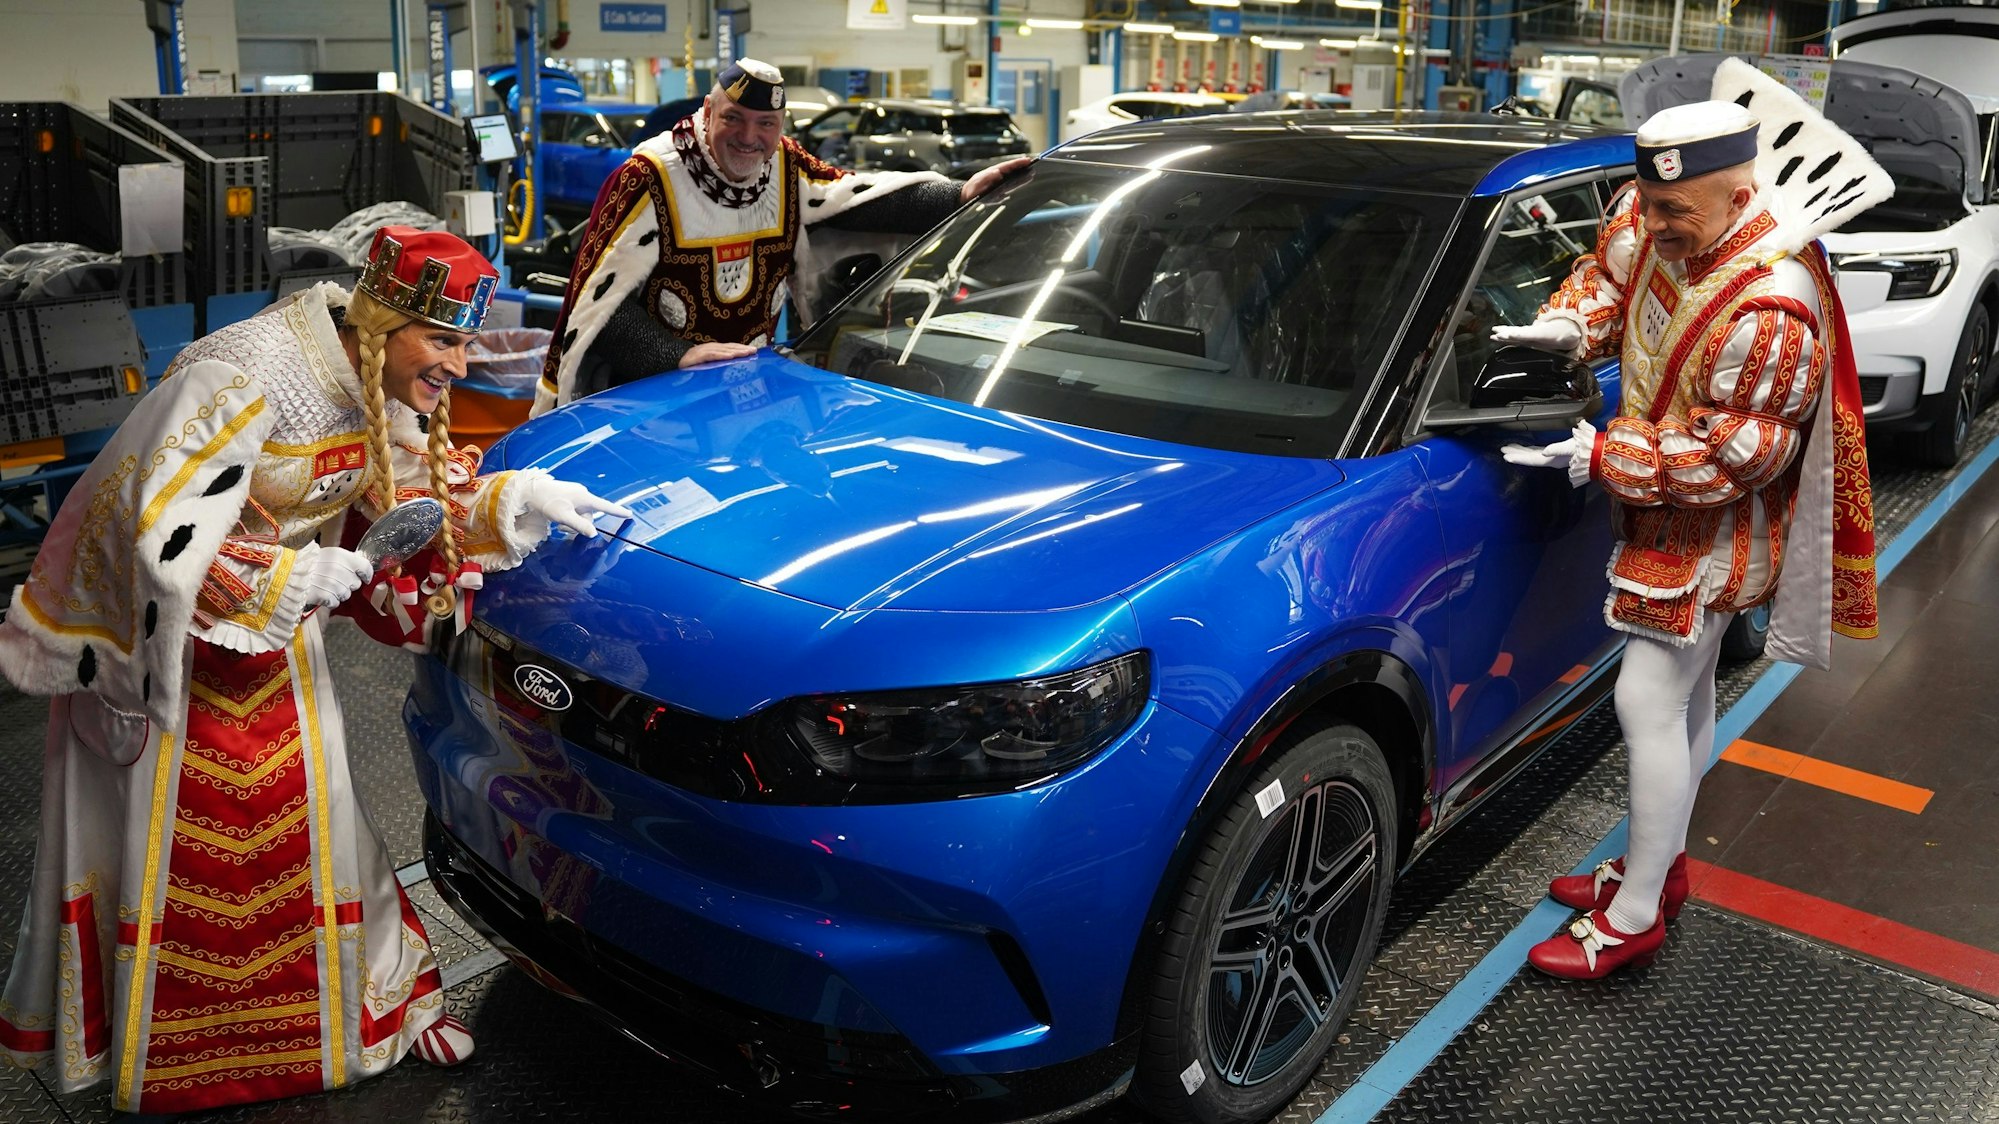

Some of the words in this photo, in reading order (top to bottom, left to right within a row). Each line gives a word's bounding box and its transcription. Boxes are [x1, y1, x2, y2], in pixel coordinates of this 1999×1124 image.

[430, 20, 445, 60] STAR
[718, 24, 731, 58] STAR
[522, 669, 562, 706] Ford
